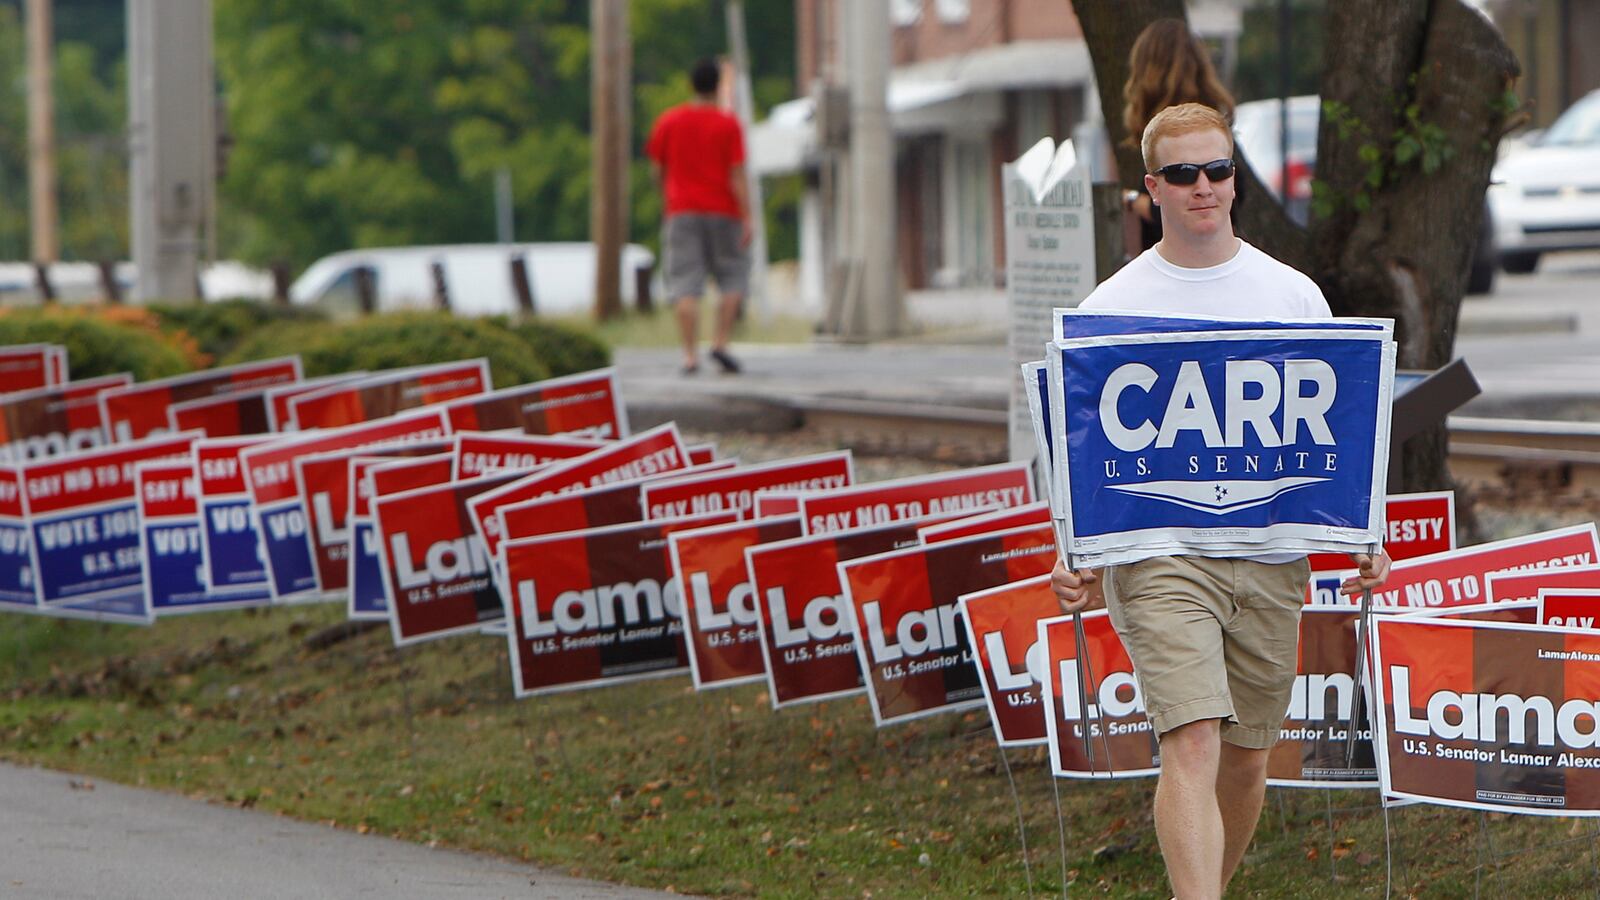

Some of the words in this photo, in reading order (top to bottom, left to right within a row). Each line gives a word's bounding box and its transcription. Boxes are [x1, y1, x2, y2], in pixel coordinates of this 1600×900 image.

[1099, 359, 1337, 452] CARR
[202, 457, 238, 480] SAY
[252, 463, 291, 487] SAY
[1188, 451, 1338, 475] SENATE
[28, 474, 61, 500] SAY
[64, 467, 94, 494] NO
[144, 480, 180, 504] SAY
[810, 510, 851, 537] SAY
[855, 502, 891, 527] NO
[896, 501, 923, 522] TO
[927, 485, 1025, 518] AMNESTY
[41, 515, 98, 551] VOTE
[1405, 578, 1445, 607] NO
[1447, 574, 1481, 602] TO
[532, 638, 562, 655] U.S.
[563, 629, 617, 651] Senator
[620, 623, 667, 643] Lamar
[784, 648, 813, 664] U.S.
[882, 664, 907, 682] U.S.
[908, 653, 959, 676] Senator
[1007, 691, 1037, 707] U.S.
[1390, 664, 1600, 749] Lama
[1403, 739, 1432, 757] U.S.
[1436, 743, 1496, 763] Senator
[1500, 749, 1553, 768] Lamar
